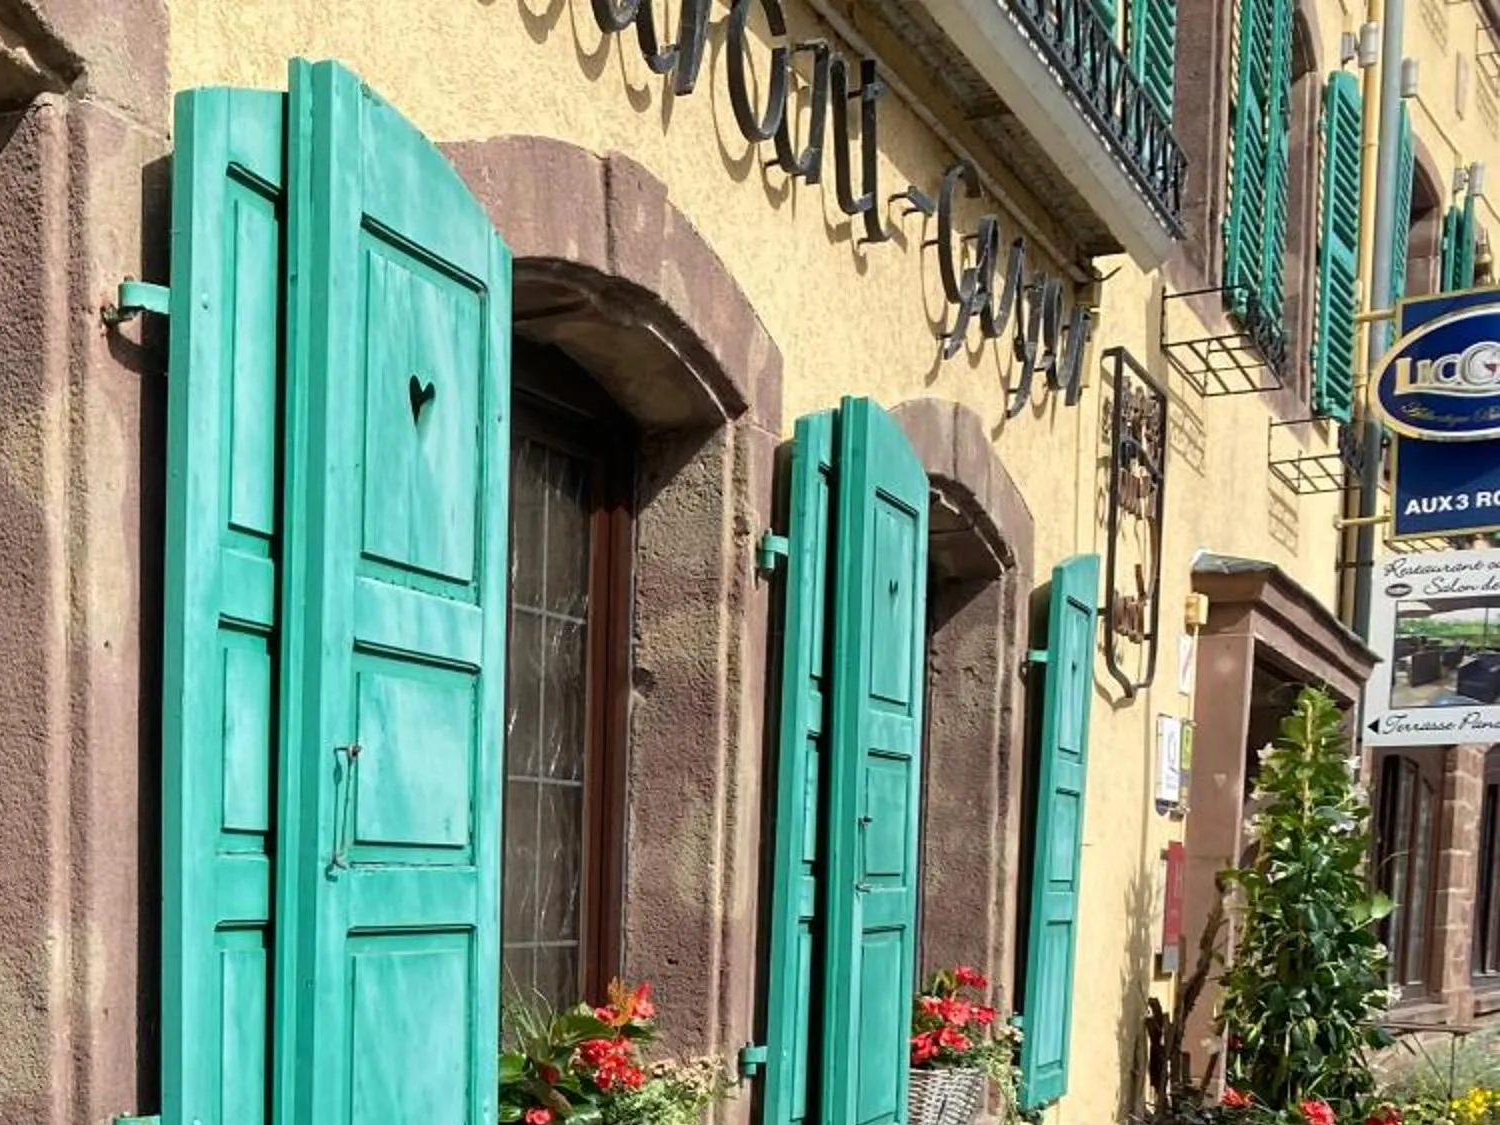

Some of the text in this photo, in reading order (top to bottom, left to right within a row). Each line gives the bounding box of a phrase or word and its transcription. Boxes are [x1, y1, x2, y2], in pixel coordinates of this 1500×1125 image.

[1404, 495, 1453, 515] AUX
[1455, 493, 1470, 510] 3
[1423, 576, 1477, 595] Salon
[1383, 712, 1456, 735] Terrasse
